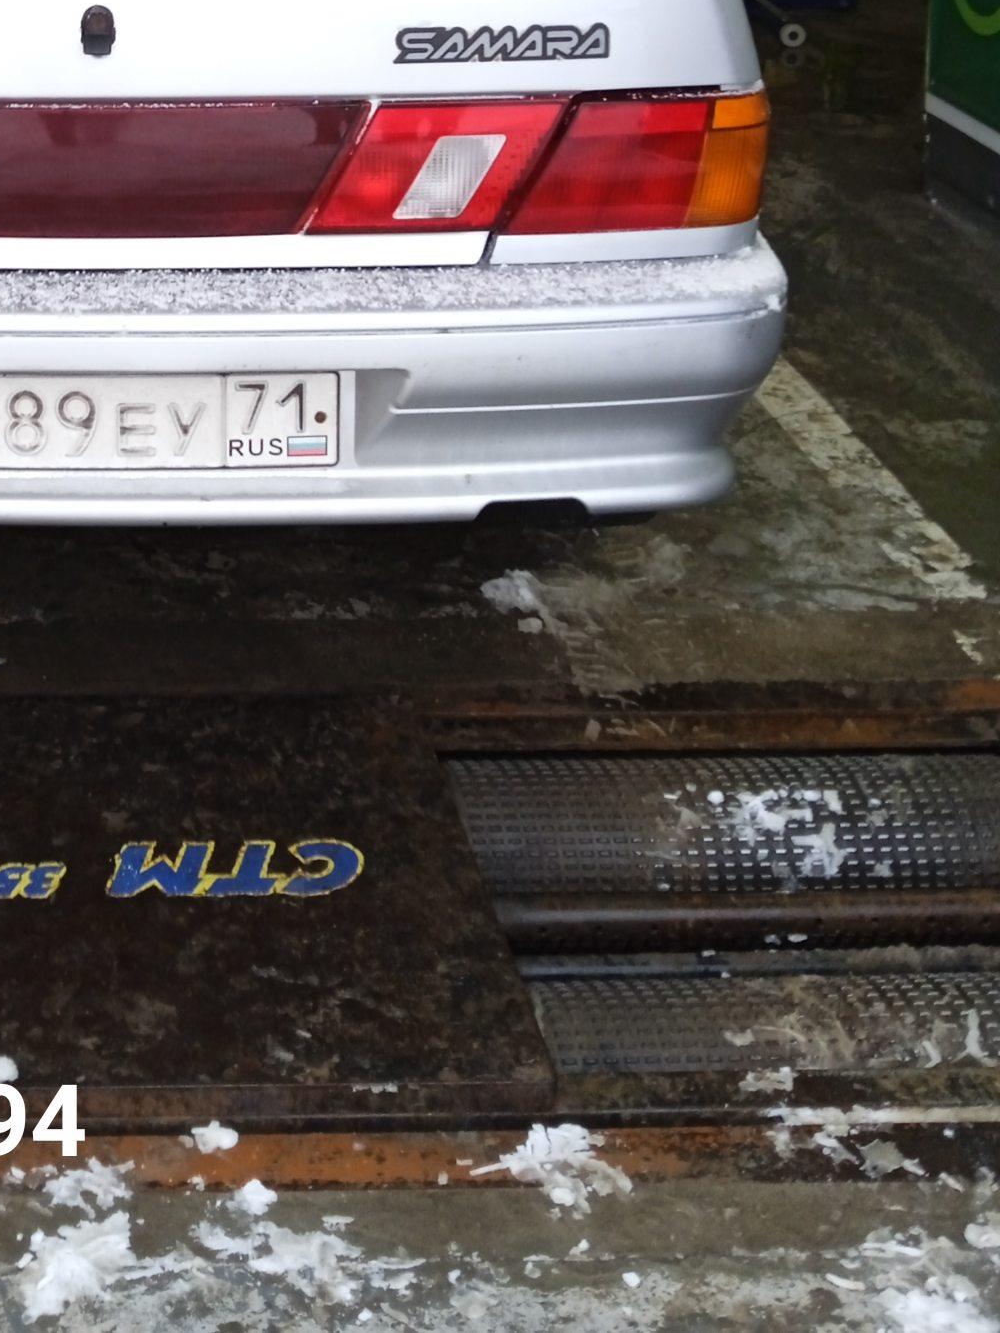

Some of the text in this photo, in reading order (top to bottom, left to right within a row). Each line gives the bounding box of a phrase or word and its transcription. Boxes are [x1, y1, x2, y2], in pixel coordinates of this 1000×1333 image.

[393, 23, 610, 64] SAMARA
[234, 380, 308, 435] 71
[228, 438, 284, 457] RUS
